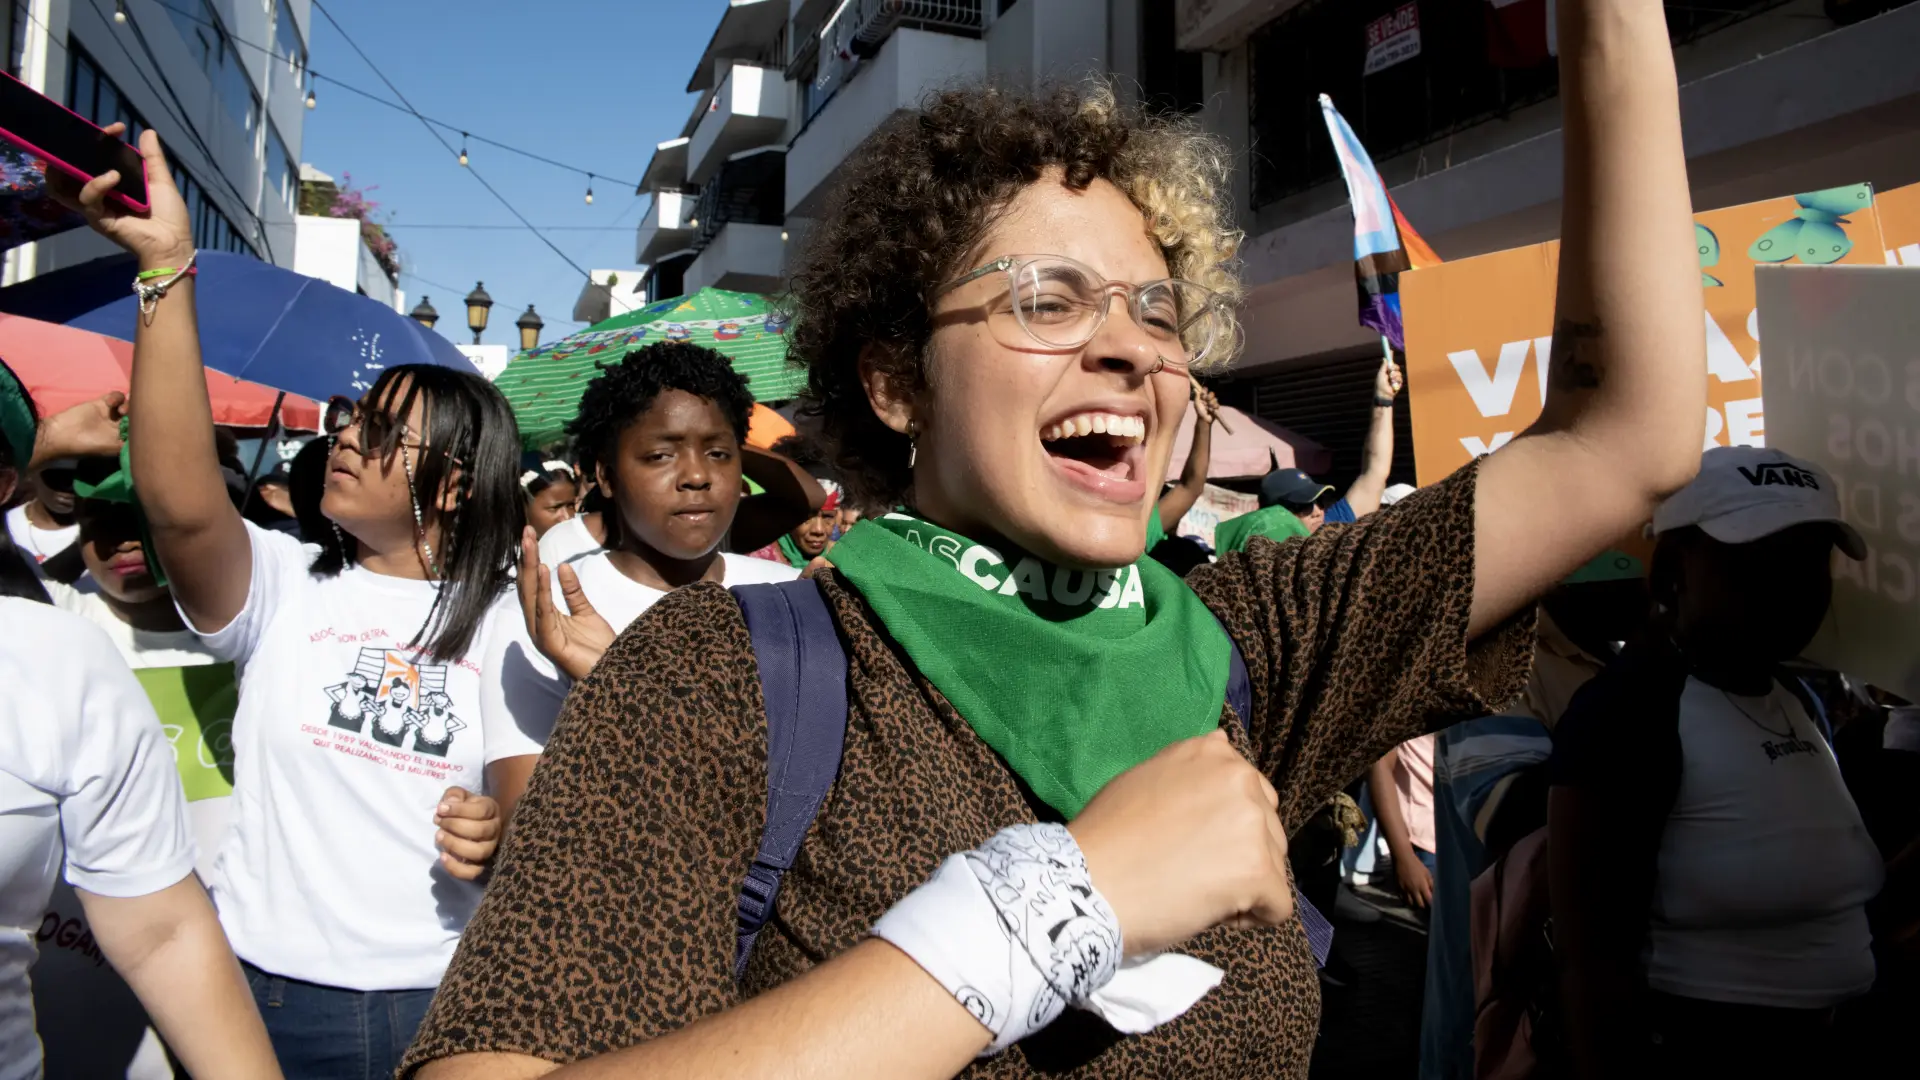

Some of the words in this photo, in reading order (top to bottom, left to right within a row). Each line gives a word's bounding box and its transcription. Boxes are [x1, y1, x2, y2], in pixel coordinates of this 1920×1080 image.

[1368, 22, 1380, 48] SE
[1381, 6, 1417, 38] VENDE
[1737, 462, 1821, 491] VANS
[300, 723, 328, 737] DESDE
[332, 731, 356, 744] 1989
[413, 755, 423, 765] EL
[425, 759, 464, 773] TRABAJO
[312, 738, 331, 749] QUE
[407, 766, 446, 780] MUJERES
